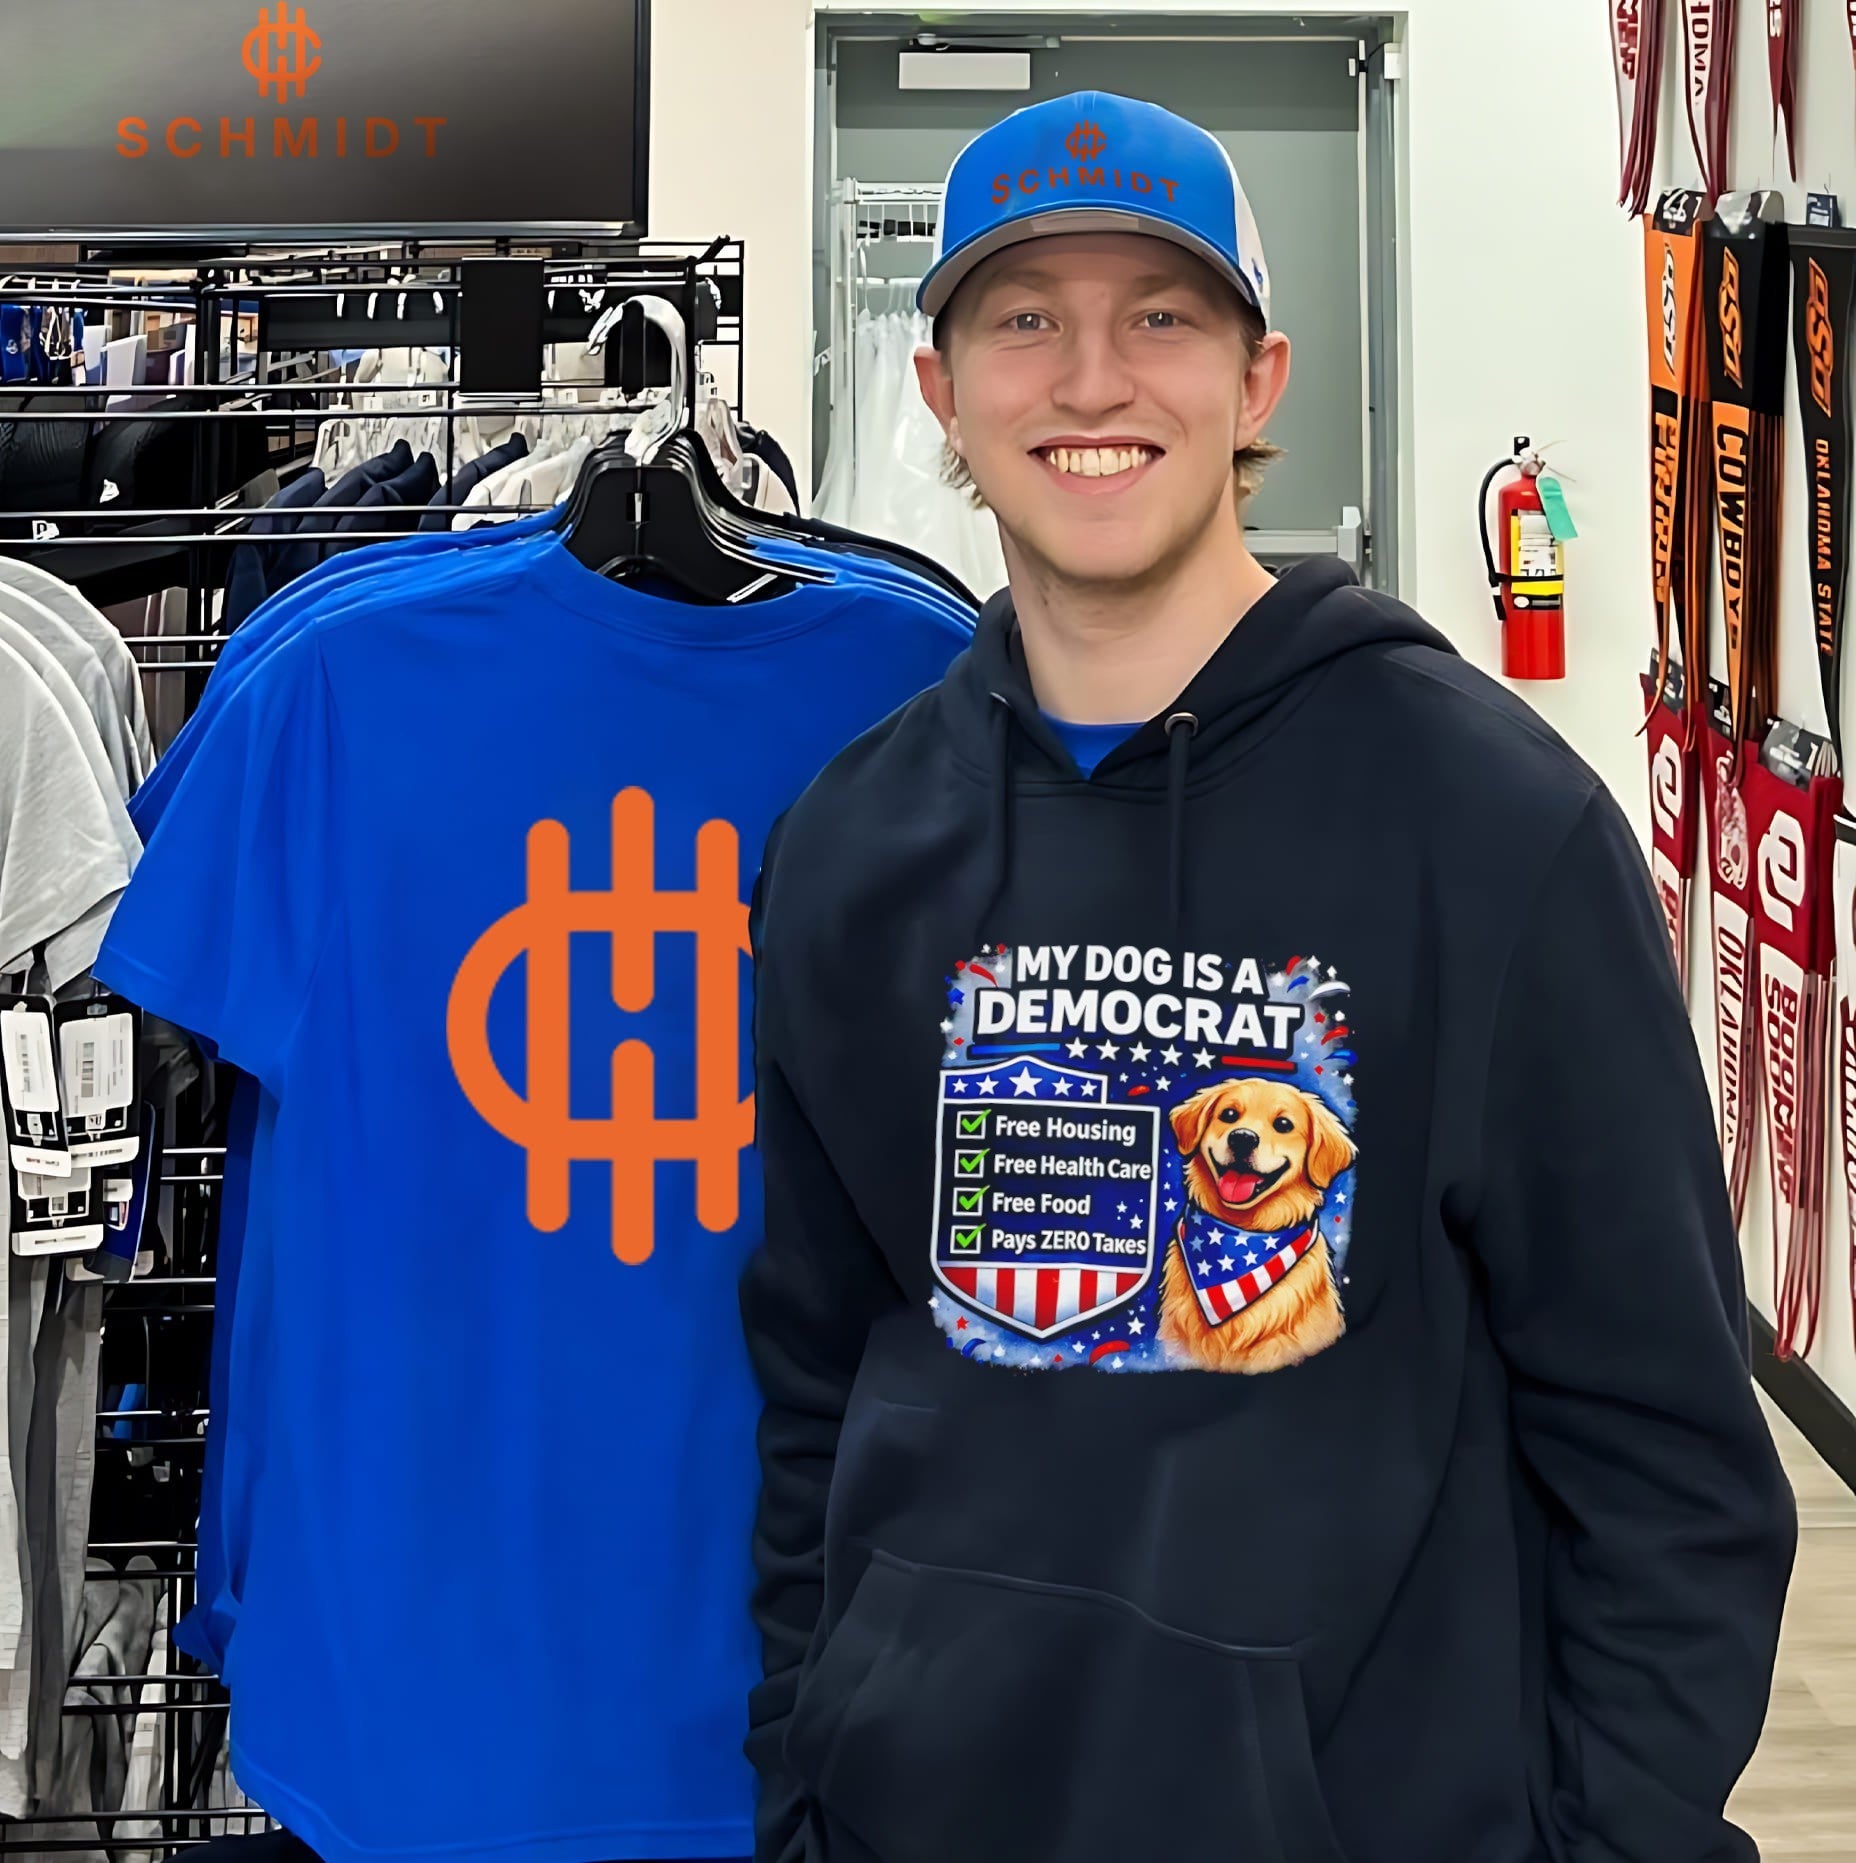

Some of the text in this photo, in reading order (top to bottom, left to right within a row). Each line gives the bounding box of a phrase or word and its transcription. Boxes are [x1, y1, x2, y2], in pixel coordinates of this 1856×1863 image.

[115, 115, 447, 159] SCHMIDT
[991, 166, 1179, 204] SCHMIDT
[1815, 438, 1832, 570] OKLAHOMA
[1016, 945, 1264, 995] MY DOG IS A
[977, 989, 1300, 1049] DEMOCRAT
[1718, 926, 1746, 1144] OKLAHOMA
[995, 1115, 1136, 1147] Free Housing
[994, 1154, 1152, 1179] Free Health Care
[992, 1192, 1091, 1215] Free Food
[991, 1229, 1037, 1255] Pays
[1040, 1230, 1090, 1250] ZERO
